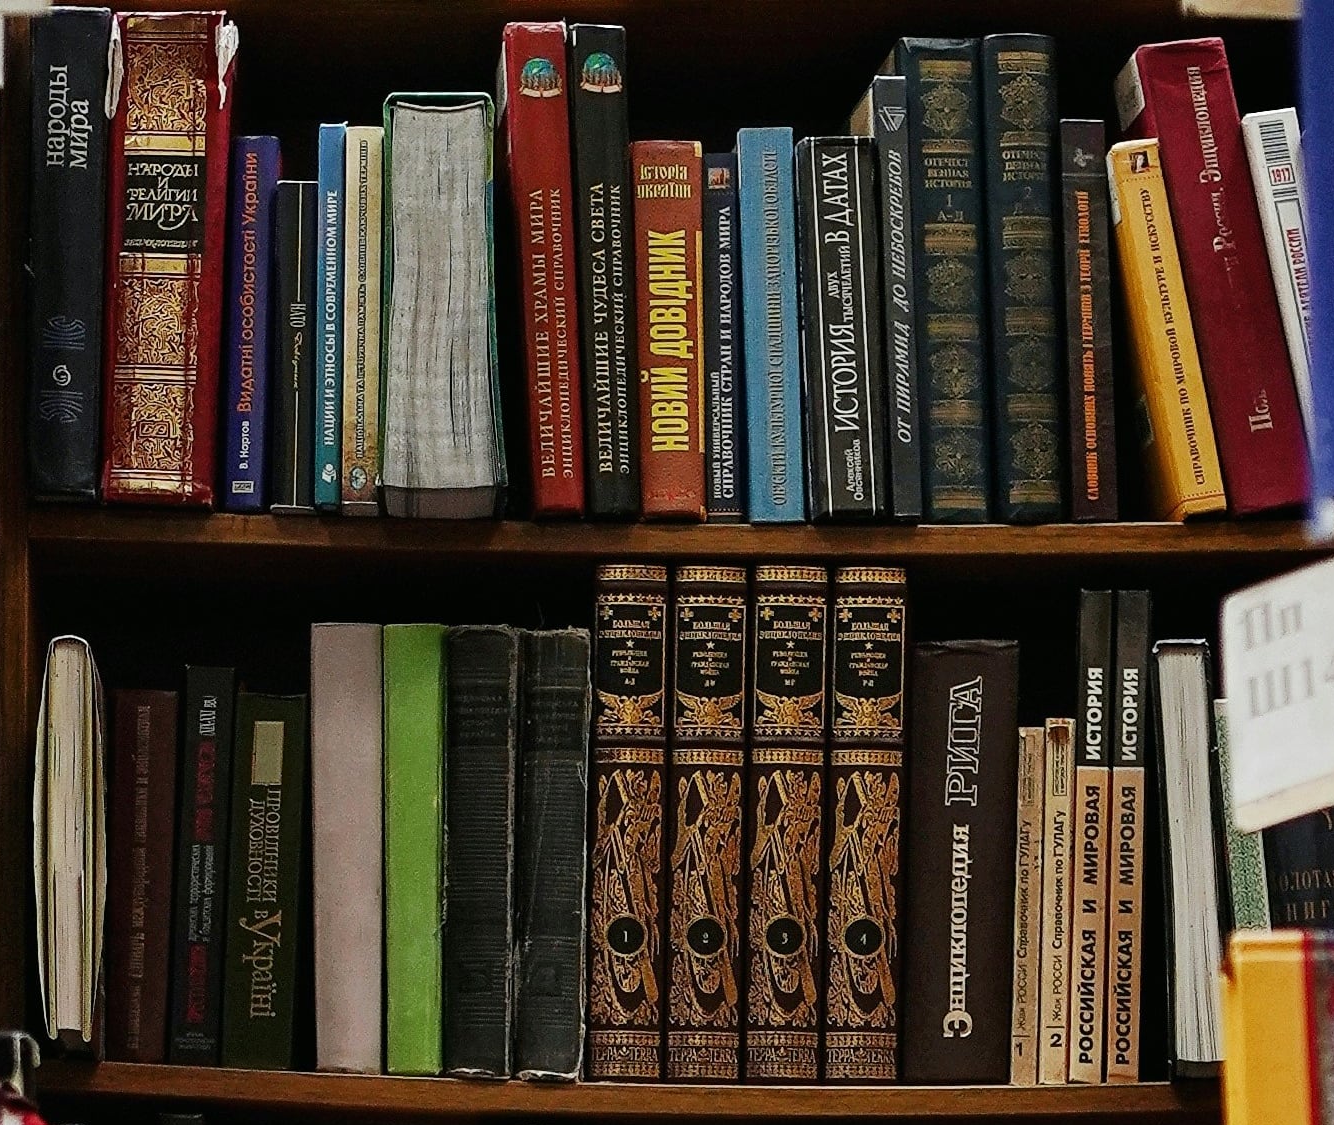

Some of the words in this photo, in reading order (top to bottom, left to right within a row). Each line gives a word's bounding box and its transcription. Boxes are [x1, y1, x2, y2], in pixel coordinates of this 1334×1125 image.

[45, 65, 69, 166] народы
[68, 99, 93, 169] мира
[1186, 66, 1221, 183] Энциклопедия
[127, 163, 198, 177] НАРОДЫ
[127, 188, 198, 201] РЕЛИГИИ
[241, 153, 260, 224] України
[821, 152, 854, 225] ДАТАХ
[1272, 168, 1291, 182] 1917
[126, 202, 199, 231] МИРА
[325, 190, 338, 224] МИРЕ
[529, 189, 545, 244] МИРА
[590, 182, 606, 242] СВЕТА
[610, 185, 623, 286] СПРАВОЧНИК
[717, 206, 732, 248] МИРА
[824, 230, 849, 242] В
[888, 150, 906, 280] НЕБОСКРЕБОВ
[1140, 188, 1160, 251] ИСКУССТВУ
[550, 188, 565, 290] СПРАВОЧНИК
[1153, 255, 1163, 264] И
[1286, 227, 1306, 264] РОССИИ
[237, 230, 258, 340] особистості
[324, 227, 338, 320] СОВРЕМЕННОМ
[533, 252, 550, 324] ХРАМЫ
[592, 249, 610, 324] ЧУДЕСА
[649, 230, 694, 358] ДОВІДНИК
[719, 254, 734, 324] НАРОДОВ
[827, 271, 839, 298] ДВУХ
[836, 245, 854, 322] ТЫСЯЧЕЛЕТИЙ
[893, 285, 910, 312] ДО
[1154, 267, 1175, 324] КУЛЬТУРЕ
[290, 303, 306, 328] НАТО
[325, 323, 337, 331] В
[720, 328, 733, 340] И
[237, 345, 256, 412] Видатні
[324, 334, 338, 386] ЭТНОСЫ
[554, 296, 574, 478] ЭНЦИКЛОПЕДИЧЕСКИЙ
[613, 292, 631, 474] ЭНЦИКЛОПЕДИЧЕСКИЙ
[720, 345, 734, 392] СТРАН
[828, 322, 860, 432] ИСТОРИЯ
[894, 321, 912, 410] ПИРАМИД
[1165, 327, 1187, 385] МИРОВОЙ
[323, 402, 339, 445] НАЦИИ
[324, 389, 337, 398] И
[533, 331, 556, 477] ВЕЛИЧАЙШИЕ
[592, 331, 614, 472] ВЕЛИЧАЙШИЕ
[641, 367, 690, 452] НОВИЙ
[710, 372, 721, 459] УНИВЕРСАЛЬНЫЙ
[1178, 388, 1191, 404] ПО
[720, 397, 735, 499] СПРАВОЧНИК
[897, 418, 912, 442] ОТ
[1181, 407, 1206, 485] СПРАВОЧНИК
[713, 462, 722, 498] НОВЫЙ
[844, 449, 855, 492] Алексей
[852, 439, 864, 501] Овсянников
[944, 676, 983, 806] РИГА
[1085, 667, 1104, 760] ИСТОРИЯ
[1121, 668, 1140, 761] ИСТОРИЯ
[246, 798, 265, 902] ДУХОВНОСТІ
[262, 789, 281, 902] ПРОВІДНИКИ
[1018, 820, 1032, 866] ГУЛАГу
[1052, 811, 1067, 857] ГУЛАГу
[1082, 785, 1100, 885] МИРОВАЯ
[1118, 786, 1136, 886] МИРОВАЯ
[1020, 870, 1030, 884] по
[1055, 860, 1064, 873] по
[254, 910, 268, 919] в
[623, 930, 628, 943] 1
[859, 930, 867, 944] 4
[943, 823, 973, 1038] Энциклопедия
[1018, 887, 1031, 959] Справочник
[1052, 876, 1066, 949] Справочник
[1083, 899, 1097, 913] И
[1119, 900, 1133, 913] И
[239, 910, 281, 1018] Україні
[781, 931, 788, 944] 3
[1018, 963, 1030, 1004] РОССИ
[1052, 954, 1063, 995] РОССИ
[1076, 929, 1097, 1064] РОССИЙСКАЯ
[1112, 930, 1133, 1065] РОССИЙСКАЯ
[1016, 1043, 1022, 1057] 1
[1050, 1034, 1062, 1048] 2
